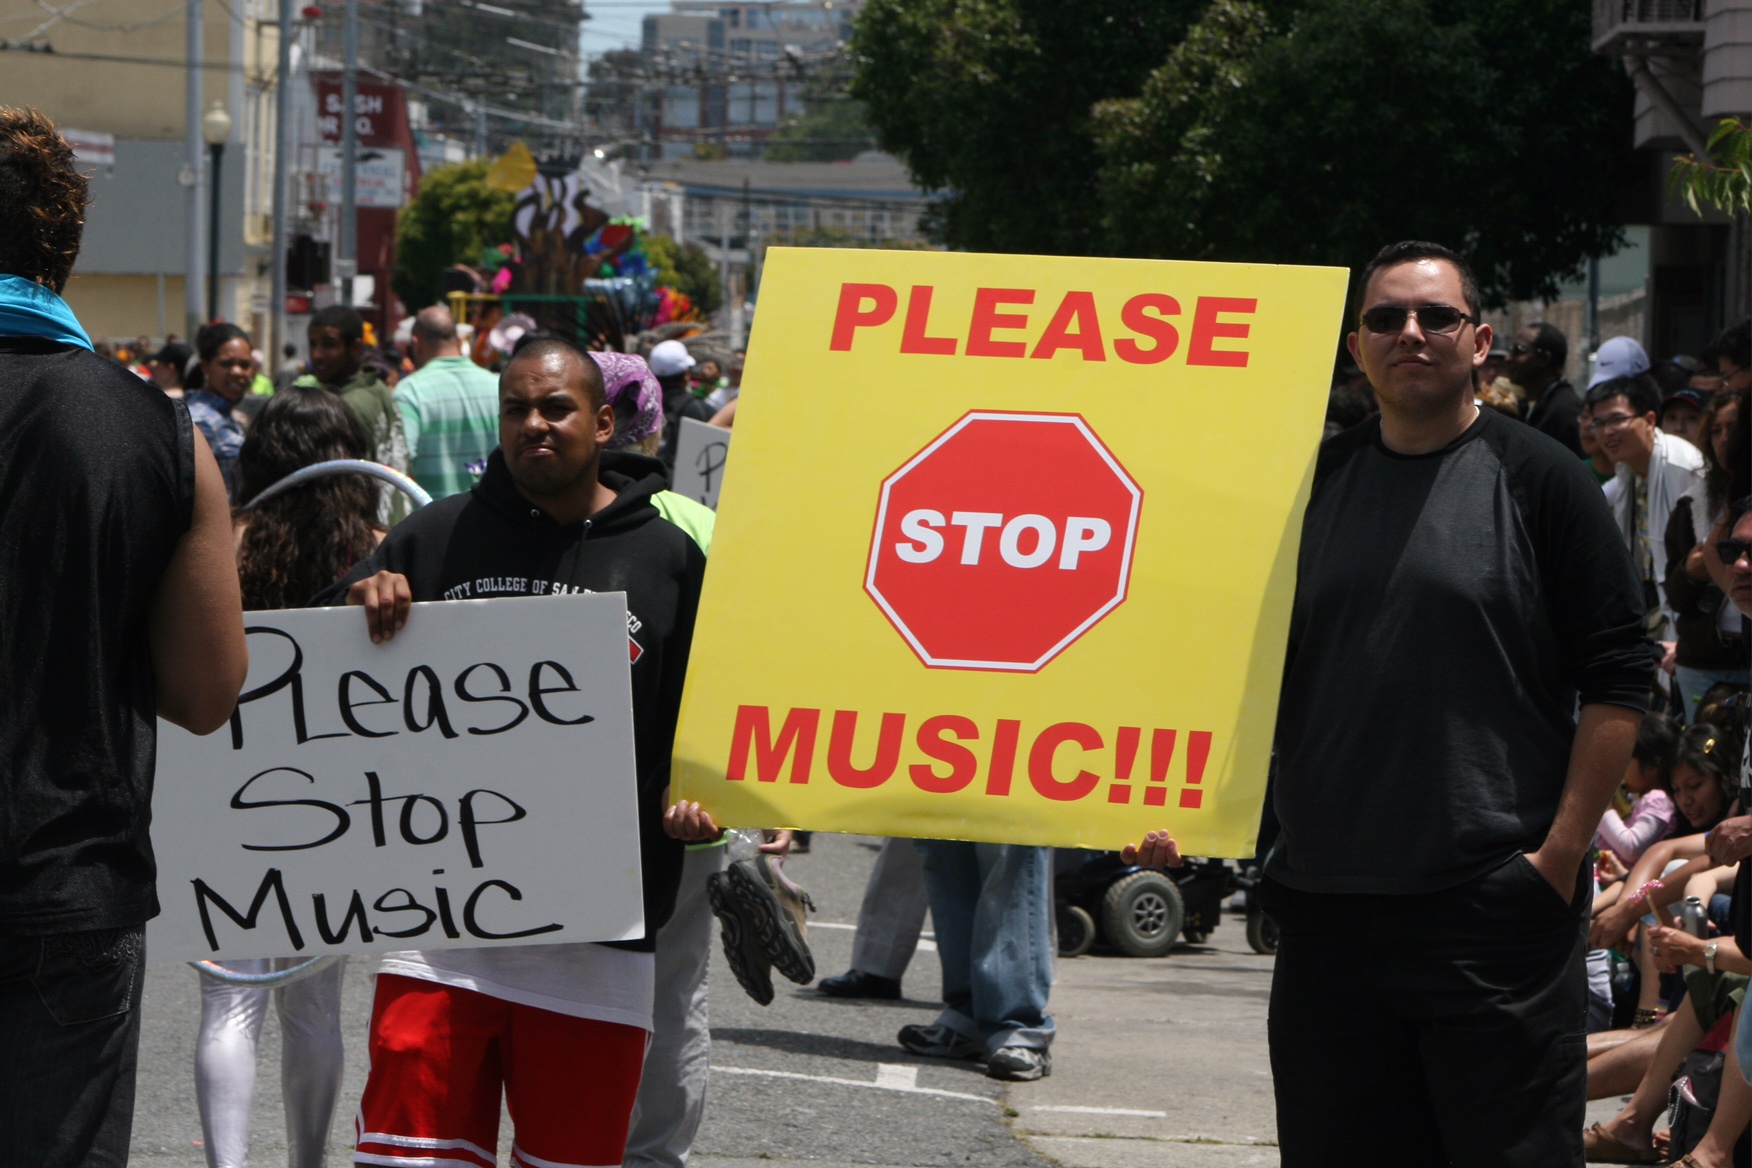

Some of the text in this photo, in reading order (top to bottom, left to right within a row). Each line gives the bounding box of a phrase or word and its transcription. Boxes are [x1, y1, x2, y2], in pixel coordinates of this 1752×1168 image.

[325, 93, 383, 114] SSH
[829, 282, 1258, 368] PLEASE
[895, 508, 1112, 571] STOP
[444, 581, 471, 602] CITY
[476, 577, 528, 593] COLLEGE
[532, 579, 548, 595] OF
[725, 704, 1213, 809] MUSIC!!!
[230, 766, 527, 868] Stop
[190, 868, 564, 952] Music
